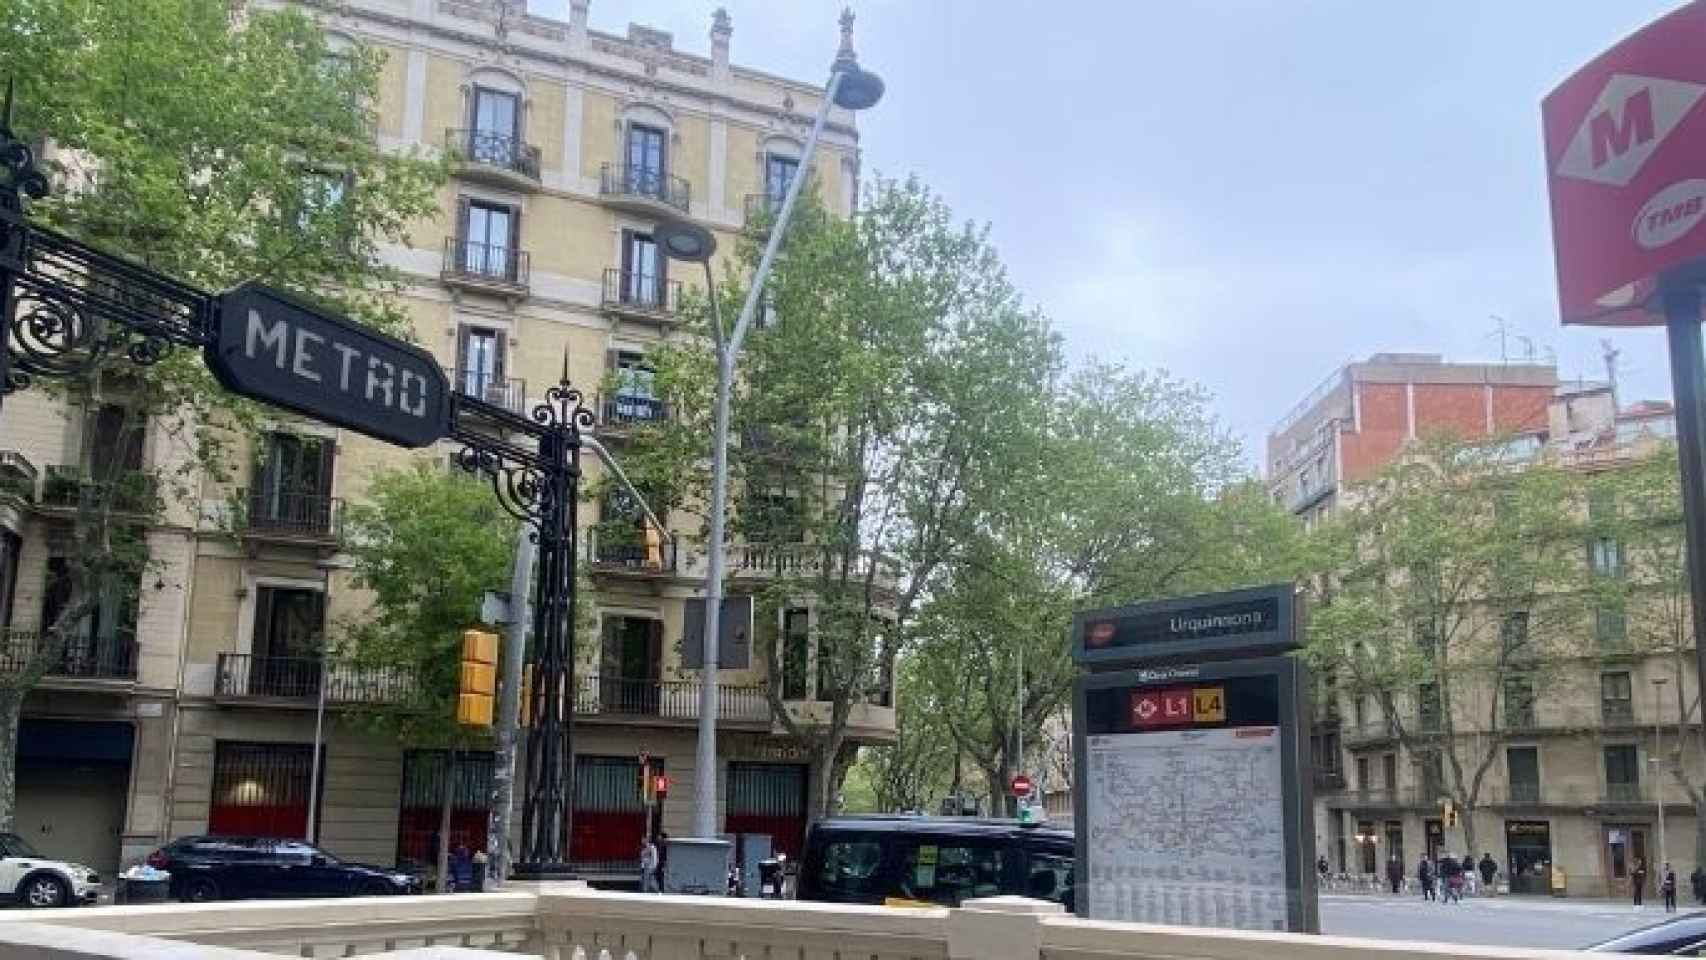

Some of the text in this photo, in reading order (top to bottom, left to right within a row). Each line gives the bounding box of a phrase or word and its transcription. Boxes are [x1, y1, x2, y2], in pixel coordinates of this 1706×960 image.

[1589, 85, 1655, 170] M
[1645, 196, 1704, 232] TMB
[245, 309, 427, 417] METRO
[1165, 697, 1188, 716] L1
[1195, 694, 1221, 715] L4
